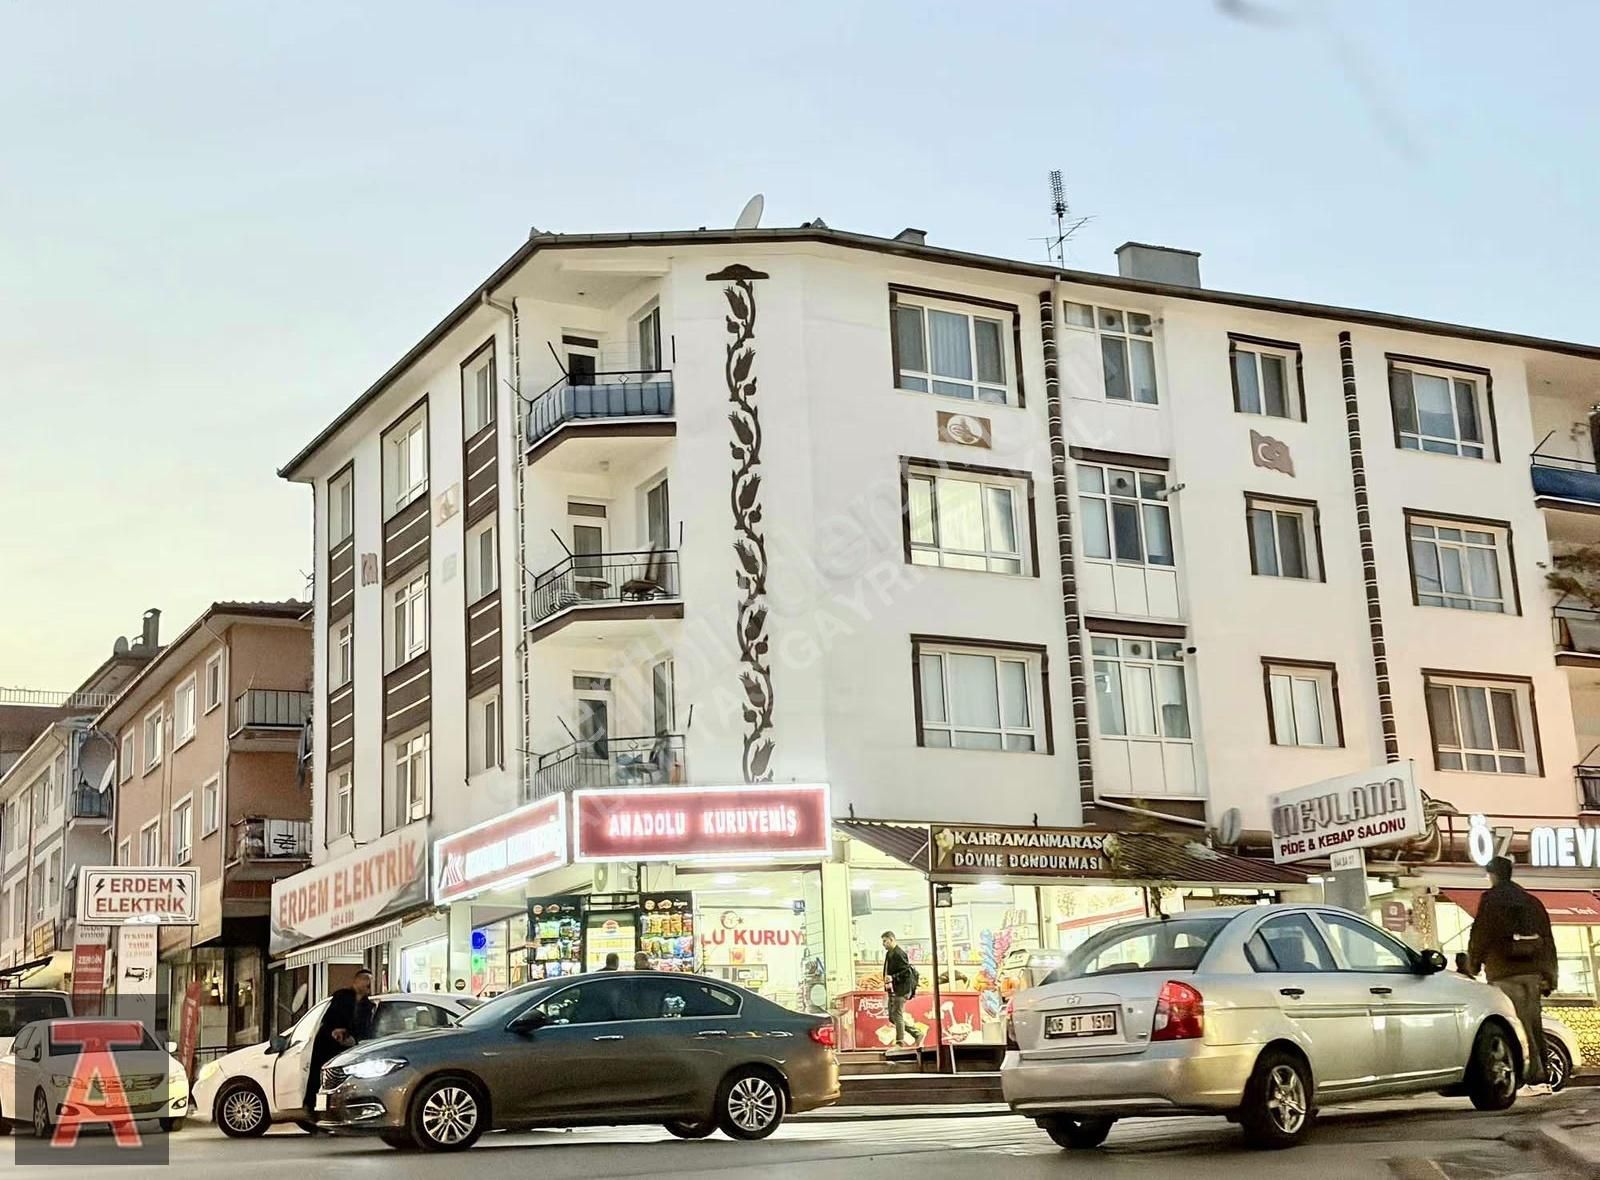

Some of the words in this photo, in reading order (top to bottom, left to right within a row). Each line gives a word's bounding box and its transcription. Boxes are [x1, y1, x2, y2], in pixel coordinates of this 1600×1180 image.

[608, 811, 685, 837] ANADOLU
[702, 805, 798, 838] KURUYEMİŞ
[1280, 837, 1306, 856] PİDE
[1308, 838, 1316, 850] &
[1318, 829, 1355, 848] KEBAP
[1357, 818, 1406, 838] SALONU
[1531, 827, 1600, 867] MEV
[110, 878, 173, 893] ERDEM
[279, 875, 328, 929] ERDEM
[333, 838, 417, 908] ELEKTRİK
[95, 895, 185, 913] ELEKTRİK
